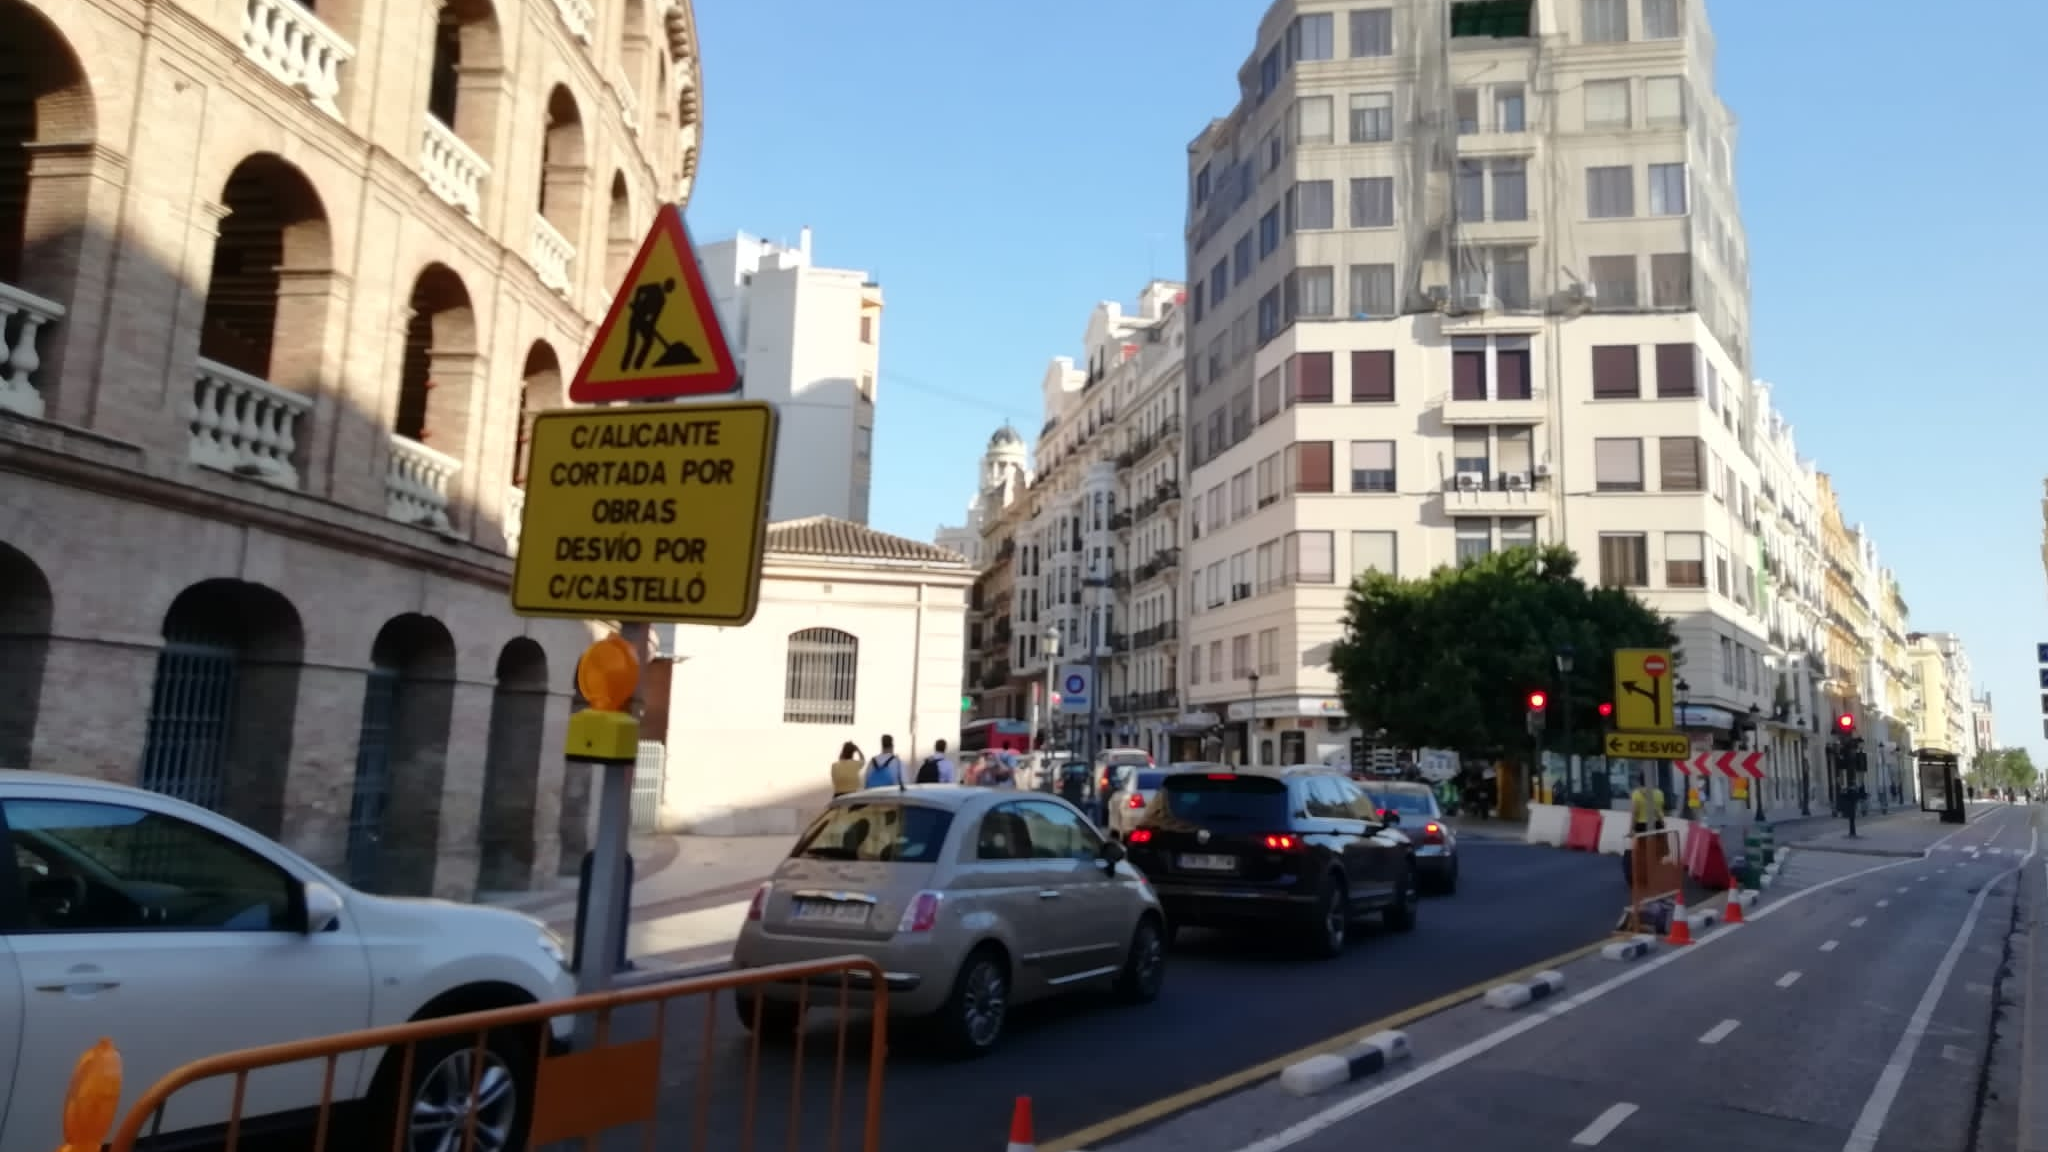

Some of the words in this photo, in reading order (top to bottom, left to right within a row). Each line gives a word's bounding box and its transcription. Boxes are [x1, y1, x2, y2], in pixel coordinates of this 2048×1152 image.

[570, 420, 721, 450] C/ALICANTE
[550, 461, 667, 487] CORTADA
[680, 458, 735, 485] POR
[591, 498, 677, 524] OBRAS
[555, 531, 642, 562] DESVÍO
[653, 537, 707, 564] POR
[548, 571, 707, 604] C/CASTELLÓ
